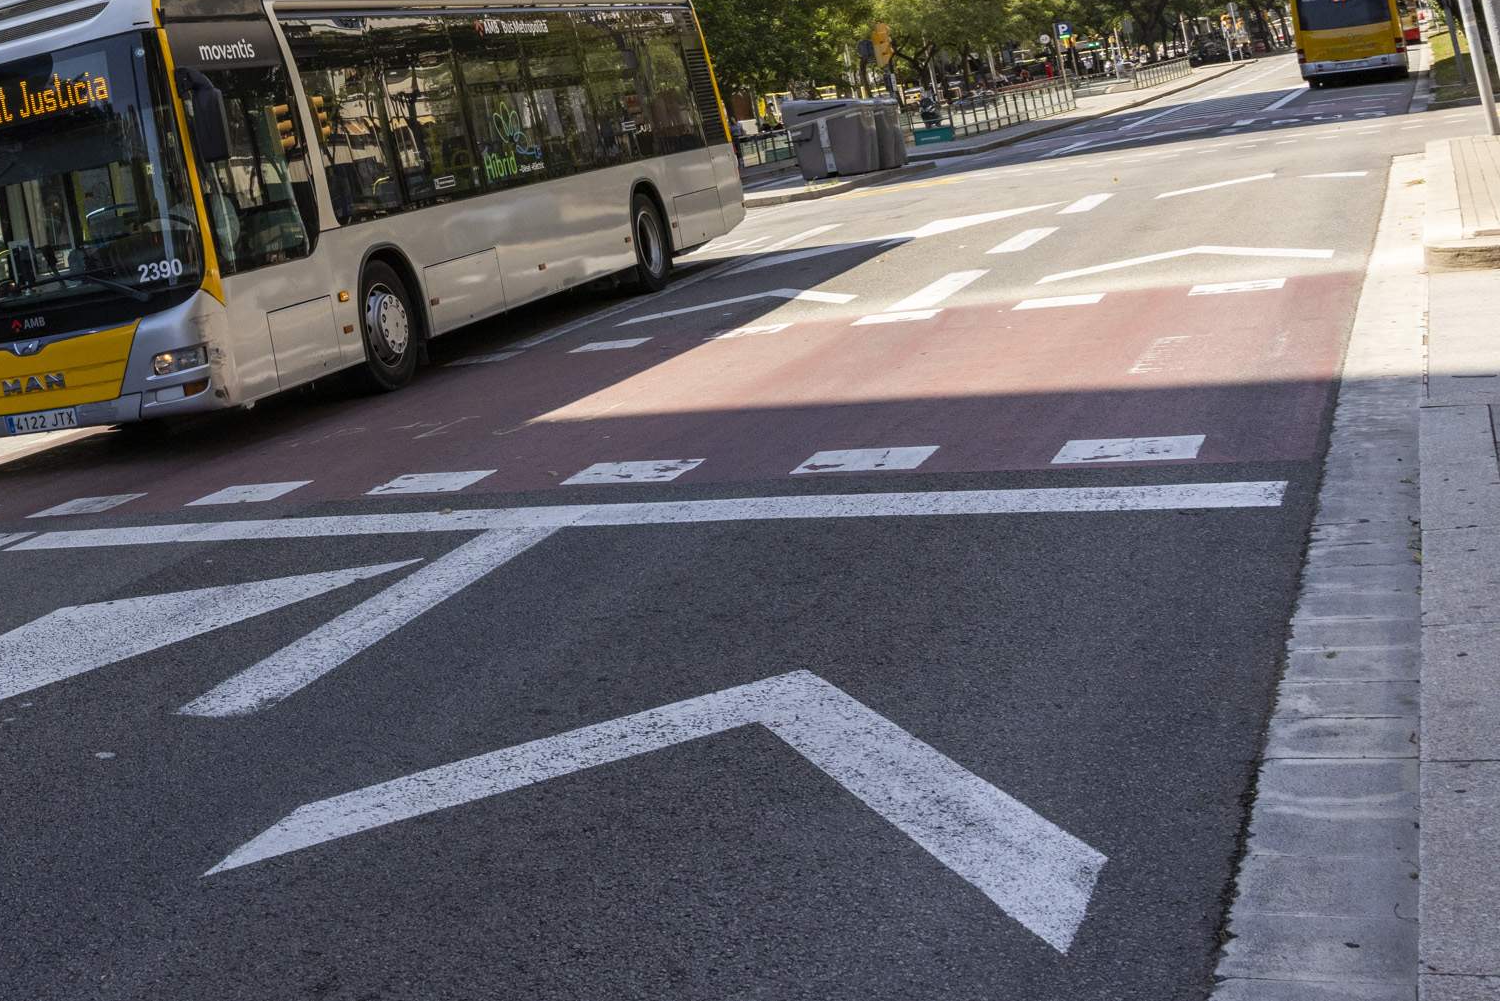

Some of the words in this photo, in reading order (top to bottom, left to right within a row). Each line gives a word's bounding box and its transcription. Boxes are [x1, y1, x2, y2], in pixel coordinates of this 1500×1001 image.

[1058, 23, 1068, 35] P
[198, 38, 256, 60] moventis
[137, 258, 183, 283] 2390
[24, 316, 46, 329] AMB
[2, 372, 66, 397] MAN
[17, 415, 47, 431] 4122
[52, 410, 76, 427] JTX
